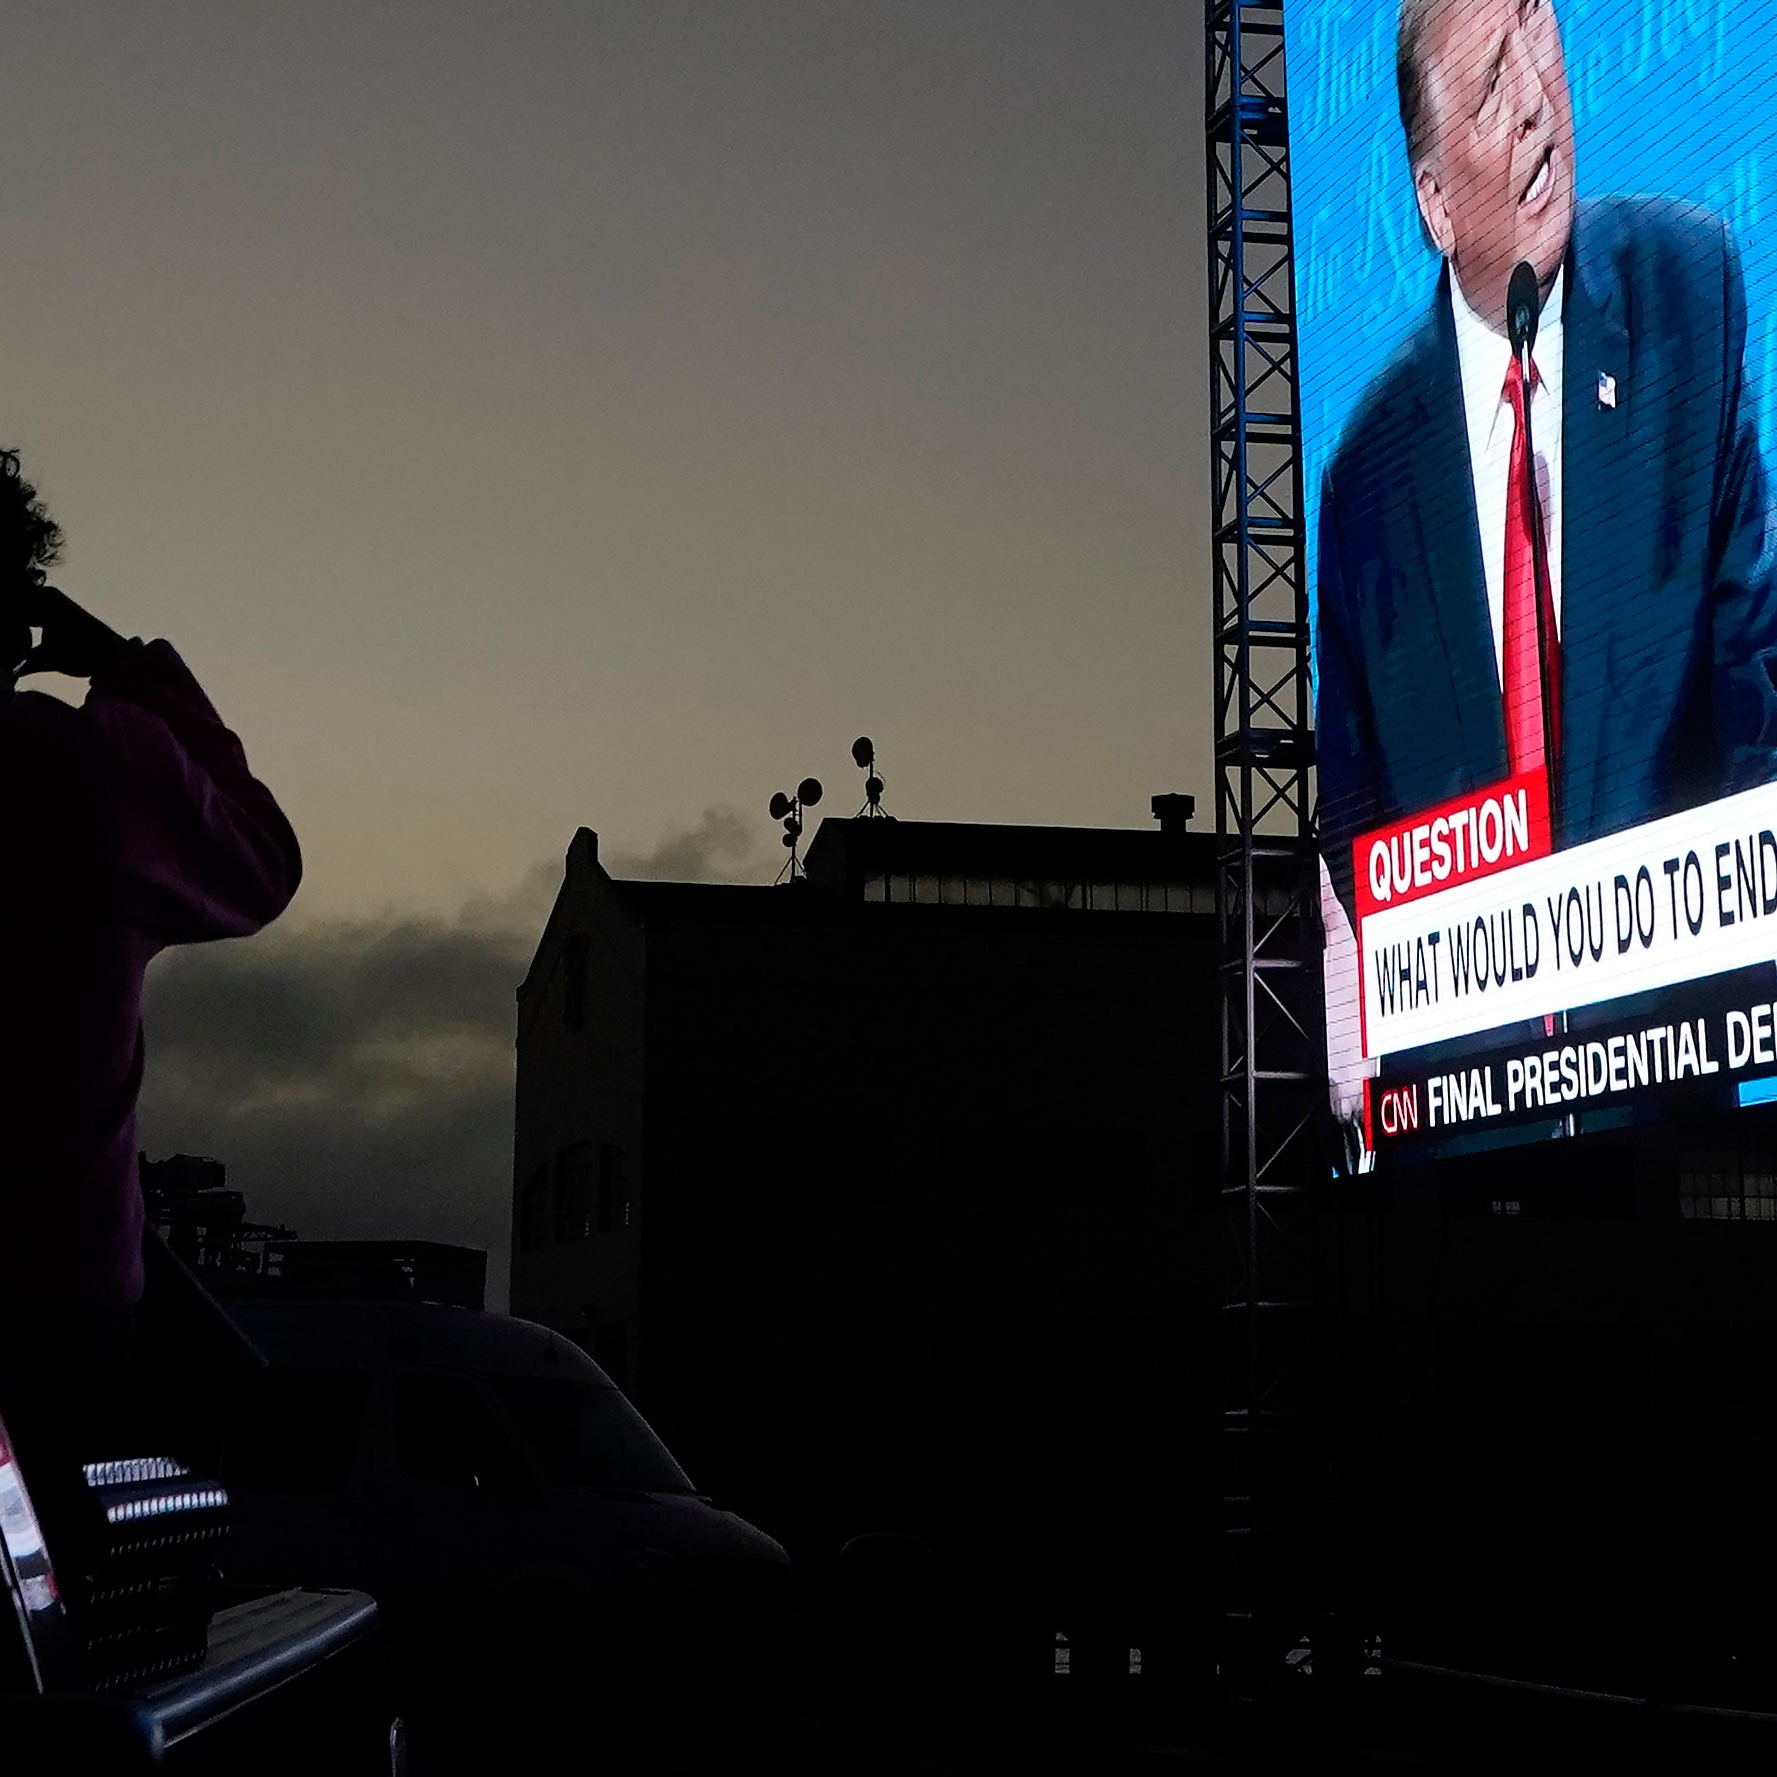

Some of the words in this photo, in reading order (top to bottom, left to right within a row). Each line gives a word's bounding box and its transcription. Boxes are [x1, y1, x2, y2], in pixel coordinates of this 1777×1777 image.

[1369, 789, 1529, 902] QUESTION
[1375, 930, 1440, 1018] WHAT
[1448, 903, 1540, 998] WOULD
[1547, 881, 1604, 971] YOU
[1614, 865, 1655, 955] DO
[1663, 850, 1704, 940] TO
[1381, 1083, 1419, 1136] CNN
[1427, 1065, 1502, 1128] FINAL
[1506, 1018, 1719, 1112] PRESIDENTIAL
